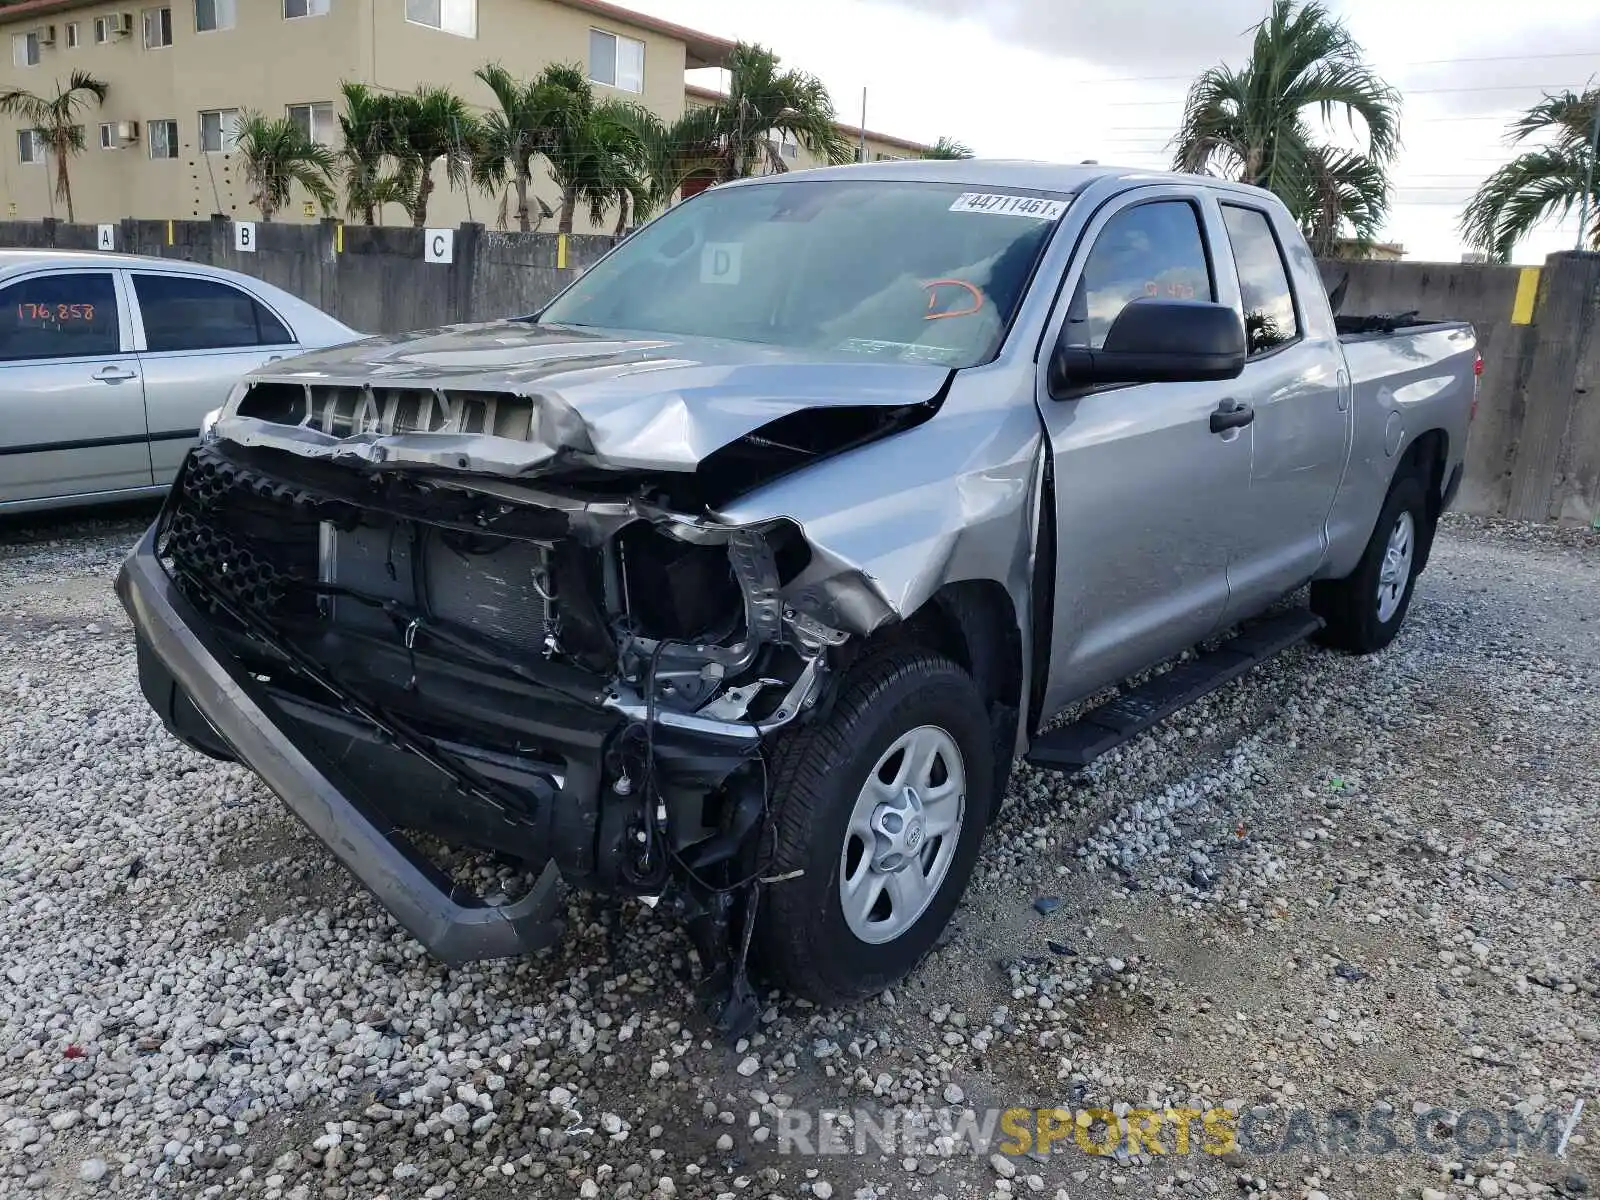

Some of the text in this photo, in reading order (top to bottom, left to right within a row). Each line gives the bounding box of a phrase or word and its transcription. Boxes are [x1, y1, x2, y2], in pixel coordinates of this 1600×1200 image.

[102, 229, 110, 246] A
[241, 227, 250, 246] B
[433, 235, 444, 257] C
[713, 249, 731, 277] D
[922, 278, 984, 320] D
[17, 303, 95, 322] 176,858
